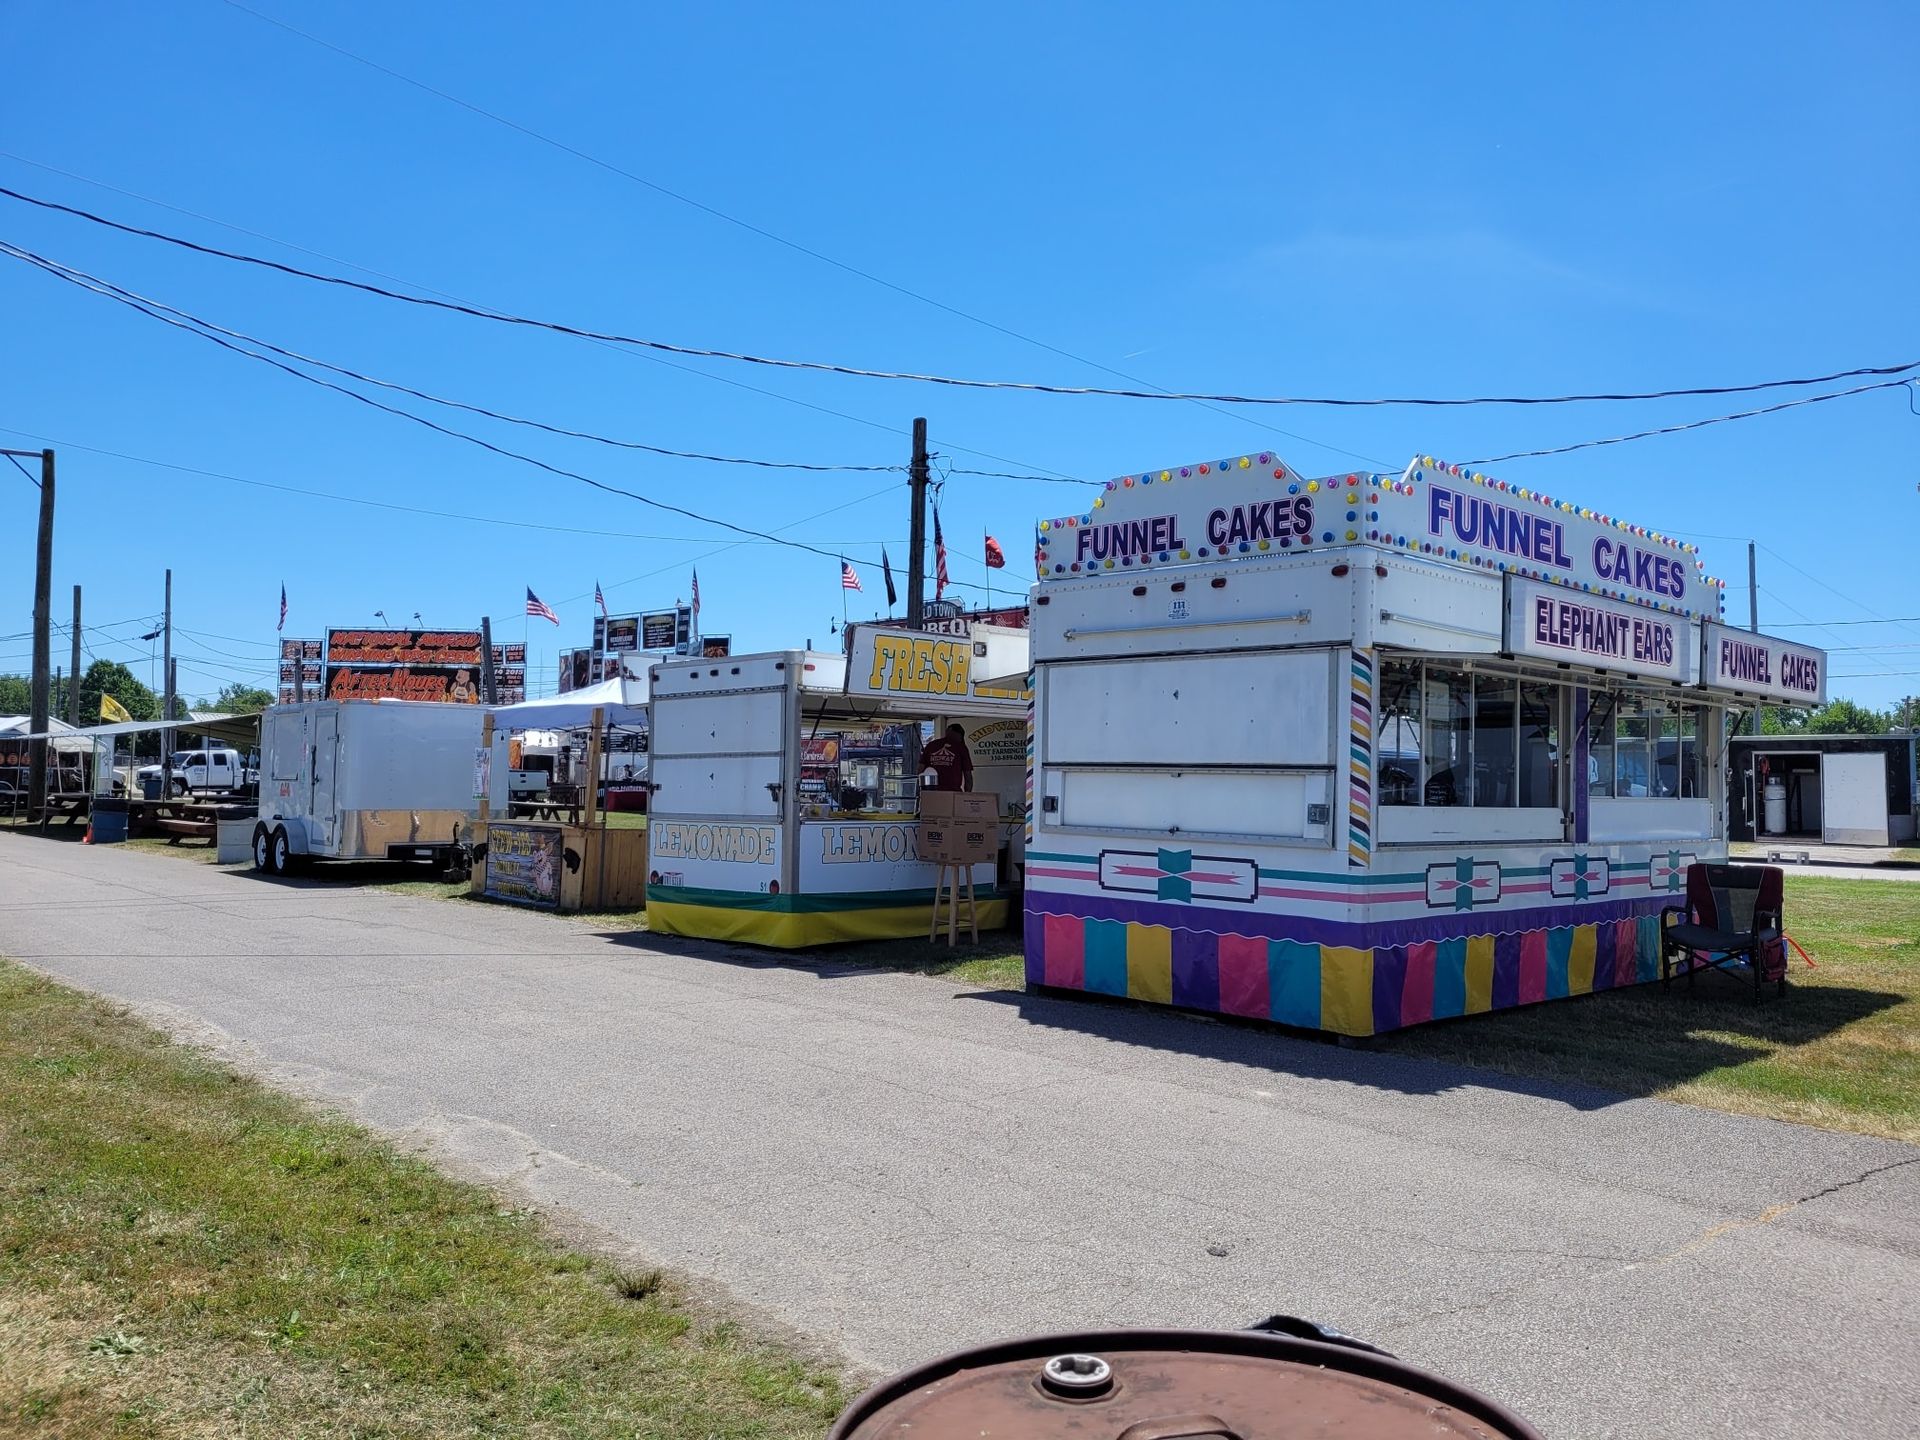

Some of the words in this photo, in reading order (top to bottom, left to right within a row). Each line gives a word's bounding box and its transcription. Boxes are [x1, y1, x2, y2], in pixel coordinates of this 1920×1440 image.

[1076, 514, 1185, 562] FUNNEL
[1206, 495, 1314, 547] CAKES
[1428, 483, 1573, 571] FUNNEL
[1592, 535, 1686, 600] CAKES
[330, 632, 412, 645] NATIONAL
[933, 604, 956, 618] TOWN
[1535, 595, 1630, 659] ELEPHANT
[1633, 617, 1673, 666] EARS
[869, 634, 971, 695] FRESH
[1721, 638, 1771, 685] FUNNEL
[1781, 652, 1818, 693] CAKES
[968, 720, 1026, 742] MIDWAY
[654, 823, 776, 865] LEMONADE
